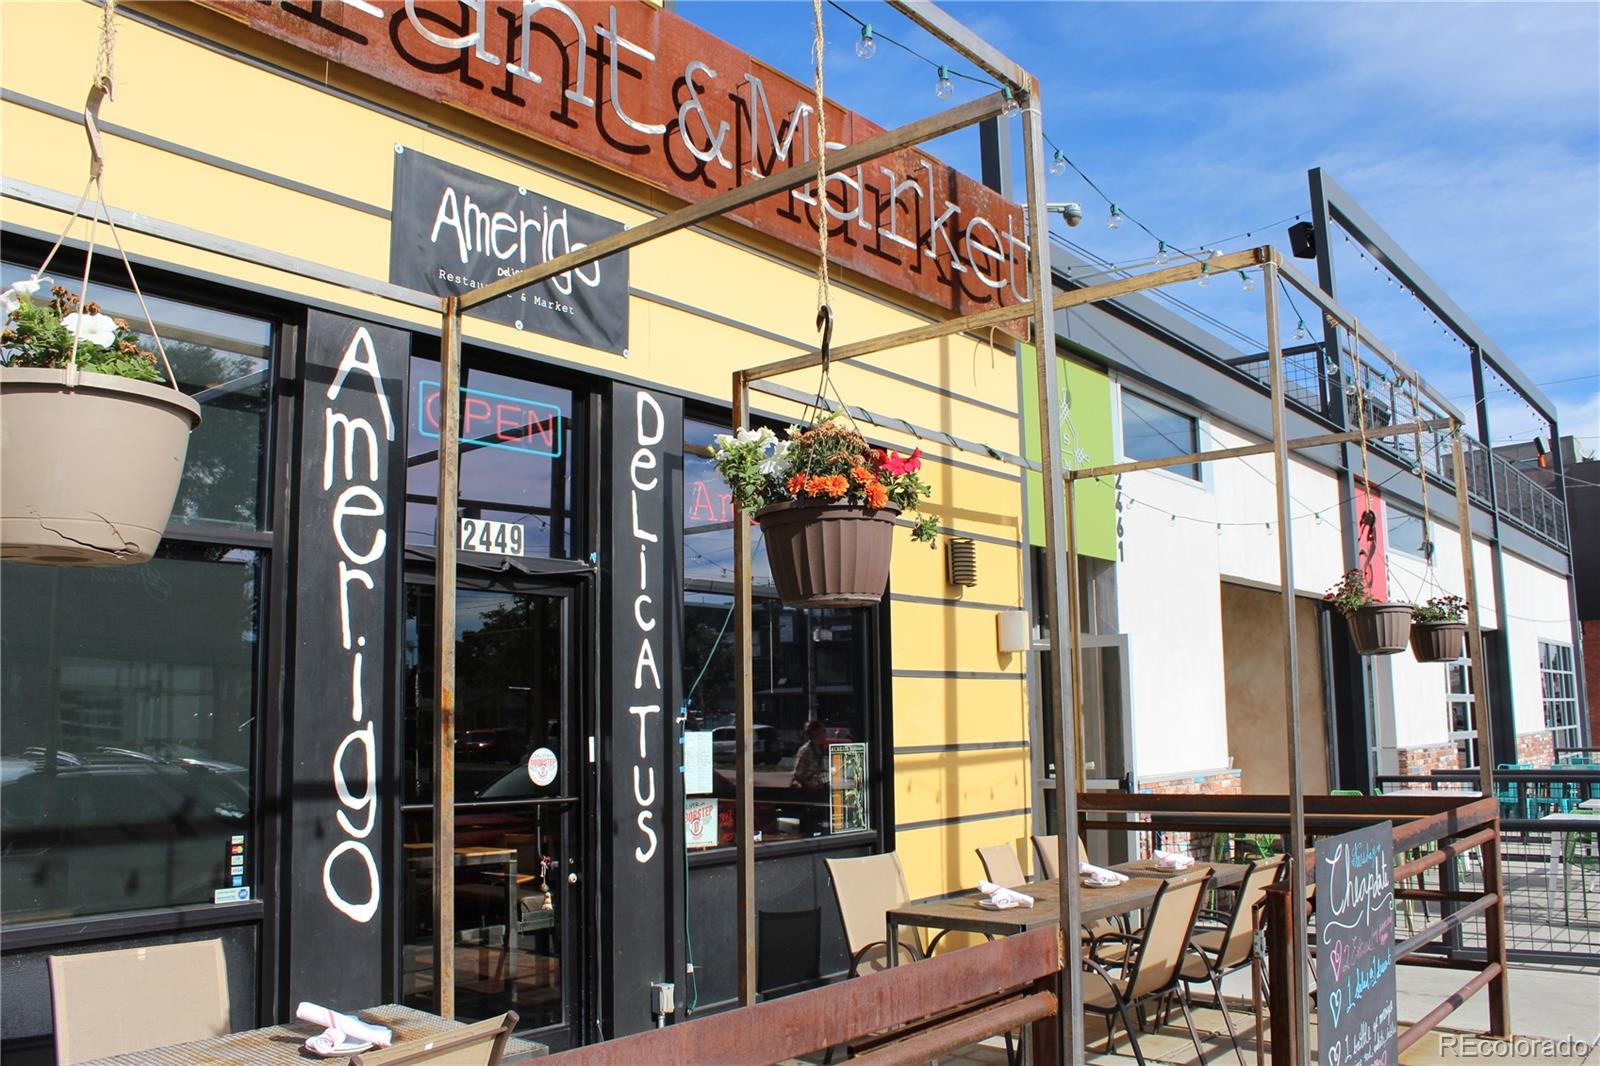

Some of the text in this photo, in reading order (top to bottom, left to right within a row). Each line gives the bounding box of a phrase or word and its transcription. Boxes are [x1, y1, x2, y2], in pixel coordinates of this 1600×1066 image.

[679, 60, 733, 170] &
[743, 73, 1032, 304] Market
[431, 186, 601, 296] Amerigo
[534, 295, 575, 315] Market
[463, 519, 524, 556] 2449
[323, 326, 396, 924] Amerigo
